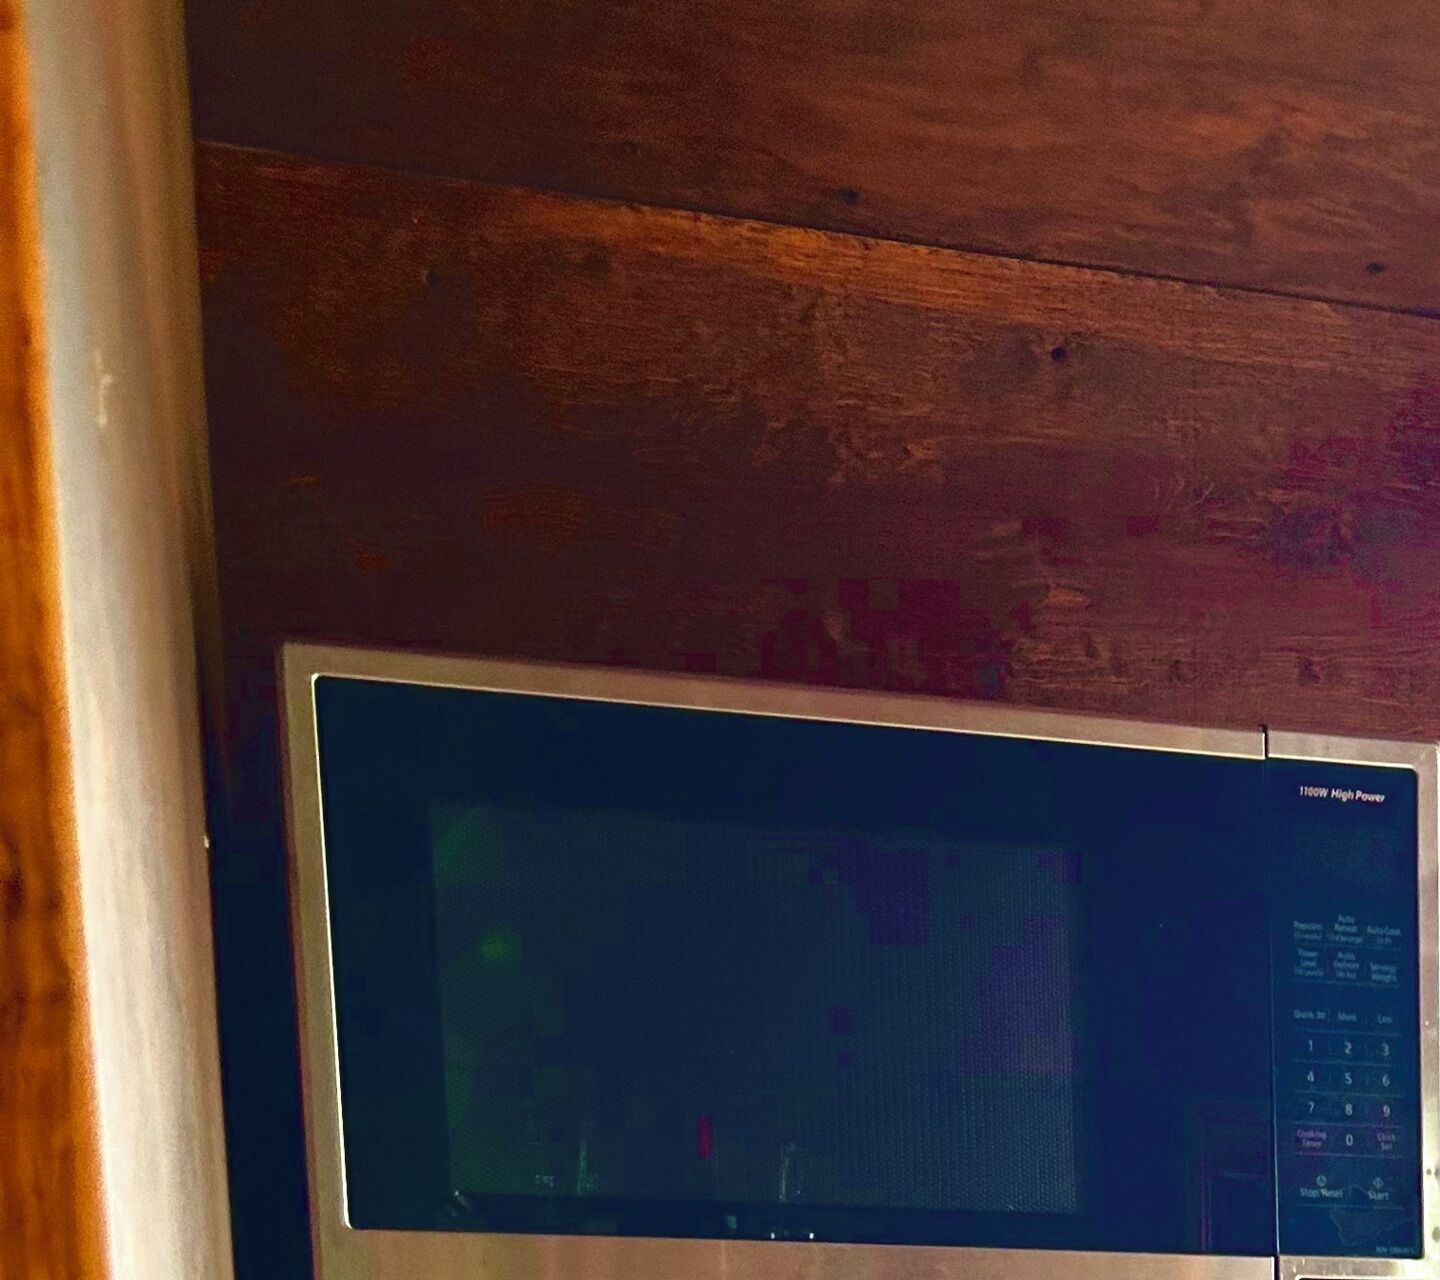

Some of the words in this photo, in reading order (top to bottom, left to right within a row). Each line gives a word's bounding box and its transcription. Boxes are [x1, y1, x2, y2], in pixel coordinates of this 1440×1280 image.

[1299, 785, 1328, 799] 1100W
[1330, 787, 1354, 803] High
[1354, 789, 1386, 803] Power
[1307, 1039, 1314, 1053] 1
[1344, 1040, 1353, 1055] 2
[1380, 1042, 1390, 1057] 3
[1306, 1070, 1315, 1083] 4
[1344, 1072, 1353, 1086] 5
[1381, 1074, 1391, 1088] 6
[1307, 1100, 1316, 1114] 7
[1344, 1102, 1354, 1117] 8
[1382, 1104, 1391, 1119] 9
[1345, 1133, 1354, 1147] 0
[1367, 1190, 1389, 1201] Start
